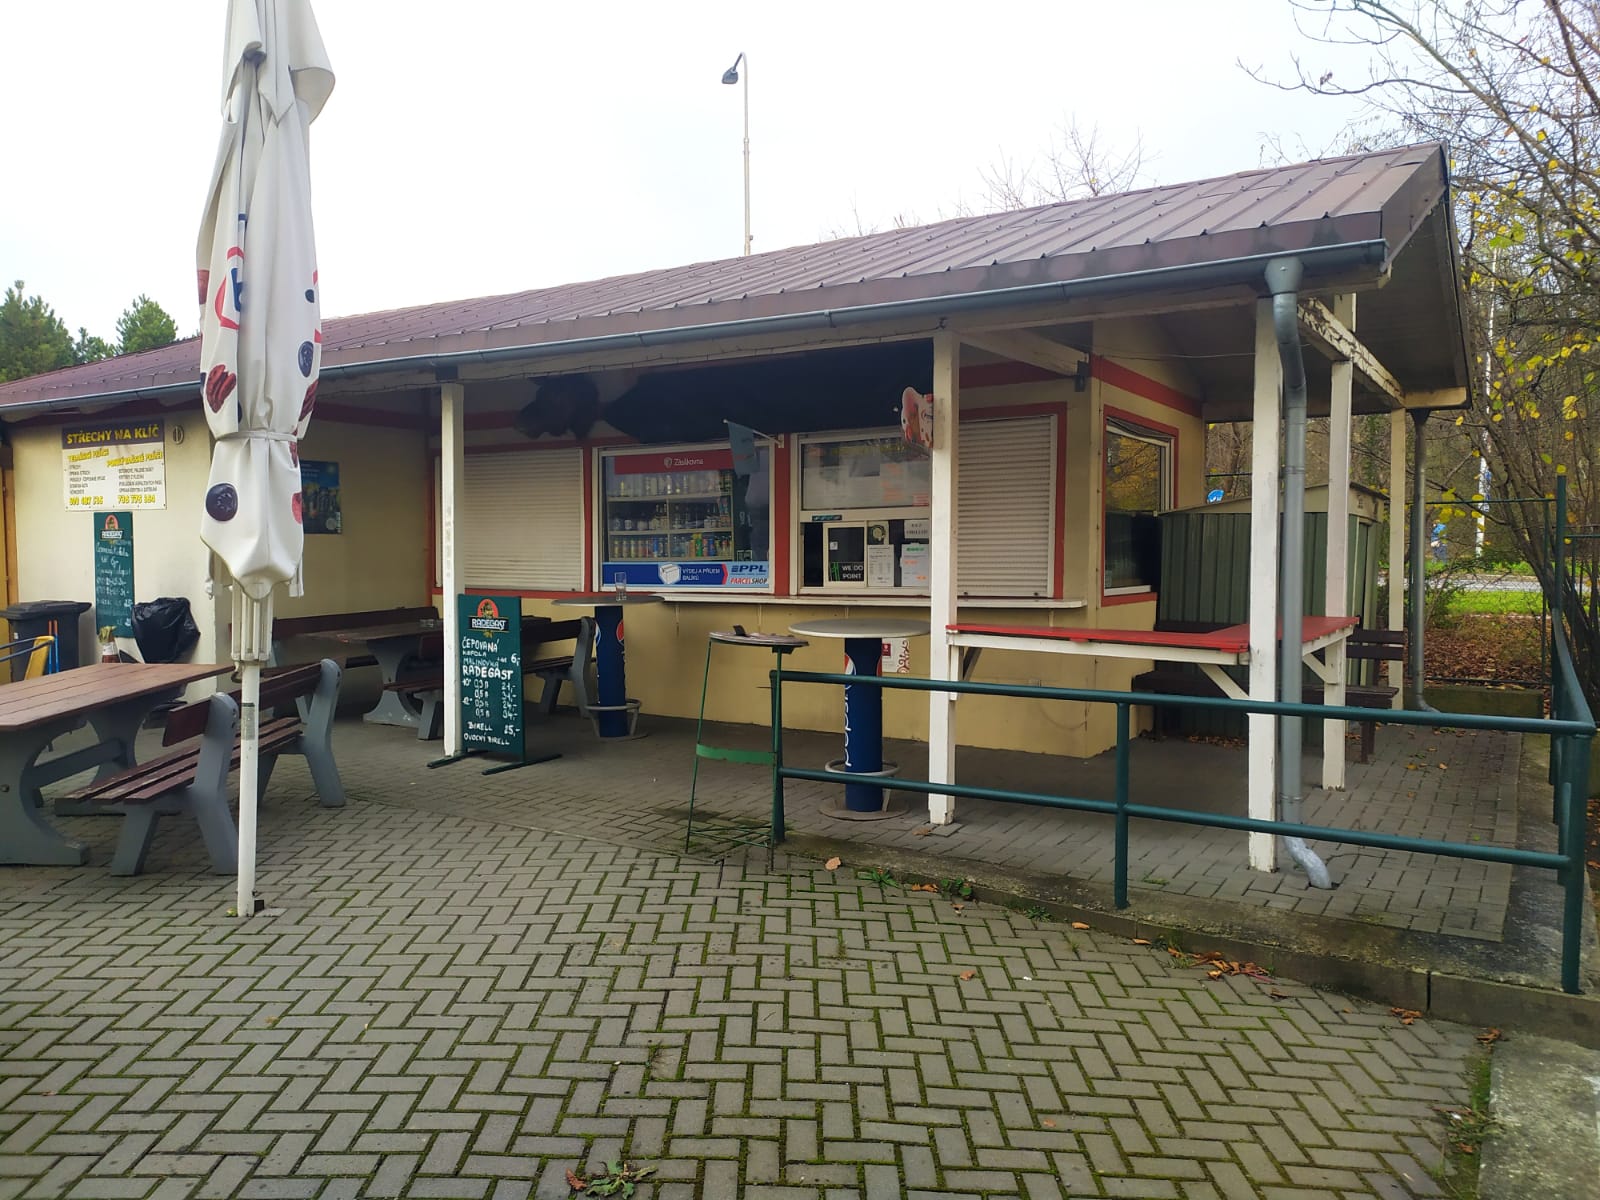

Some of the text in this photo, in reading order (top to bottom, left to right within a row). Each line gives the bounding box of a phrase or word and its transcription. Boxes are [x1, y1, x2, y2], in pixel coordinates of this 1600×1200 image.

[67, 424, 159, 444] STŘECHY NA KLÍČ
[730, 577, 768, 585] PARCELSHOP
[471, 618, 507, 630] RADEGAST
[462, 637, 498, 652] ČEPOVANÁ
[462, 665, 514, 680] RADEGAST
